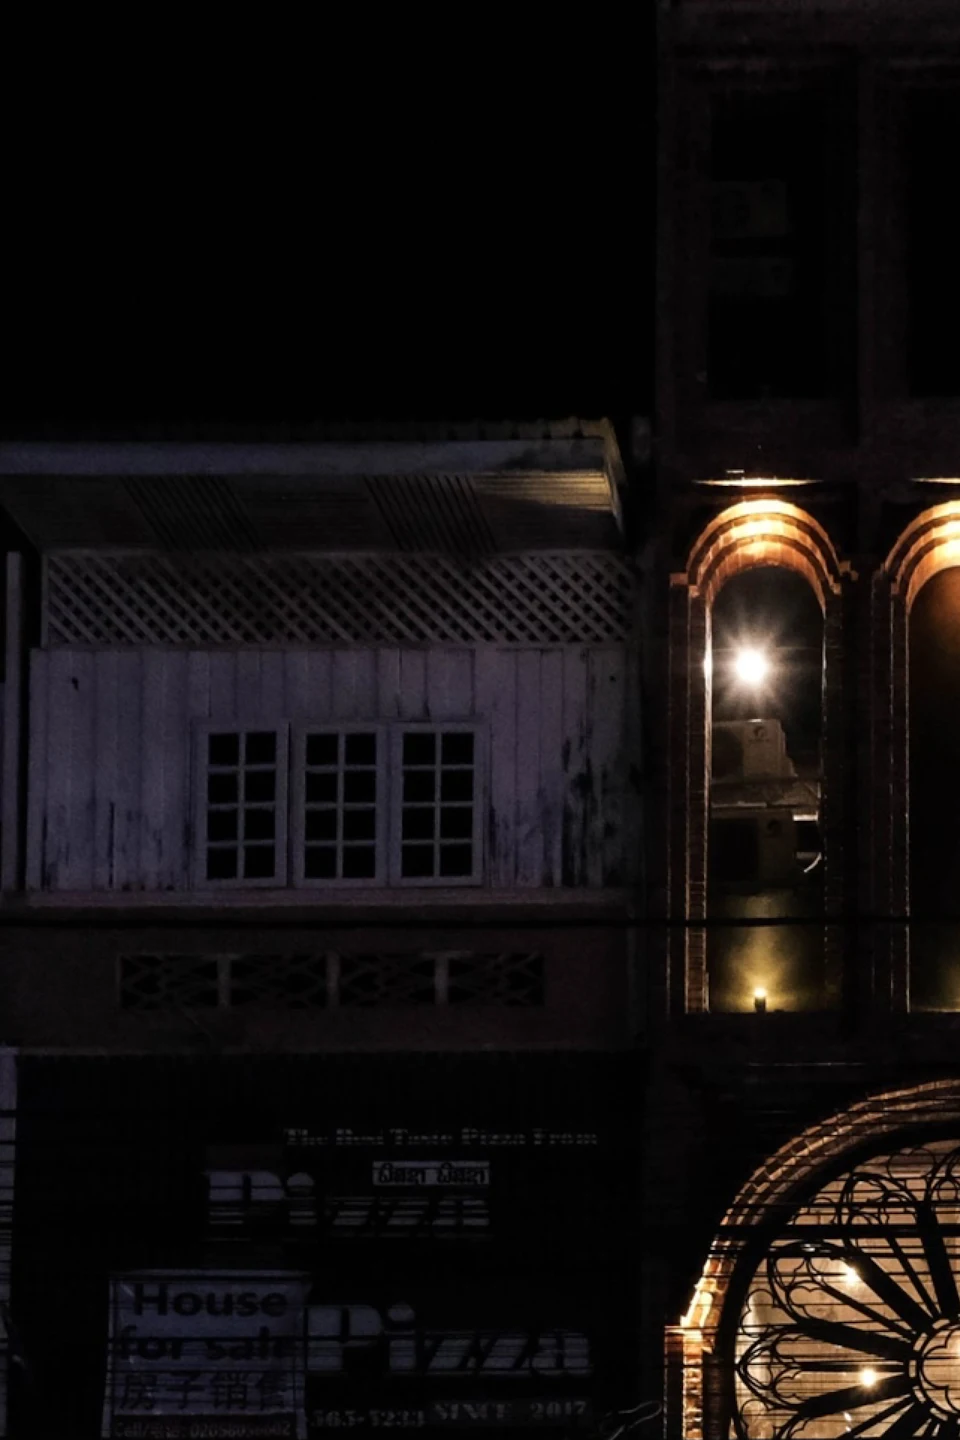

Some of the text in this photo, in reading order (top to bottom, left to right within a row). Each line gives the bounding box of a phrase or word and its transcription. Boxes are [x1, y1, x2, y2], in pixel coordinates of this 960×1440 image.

[134, 1282, 288, 1317] House
[120, 1325, 293, 1361] for sale
[304, 1302, 594, 1378] Pizza
[529, 1399, 589, 1421] 2017
